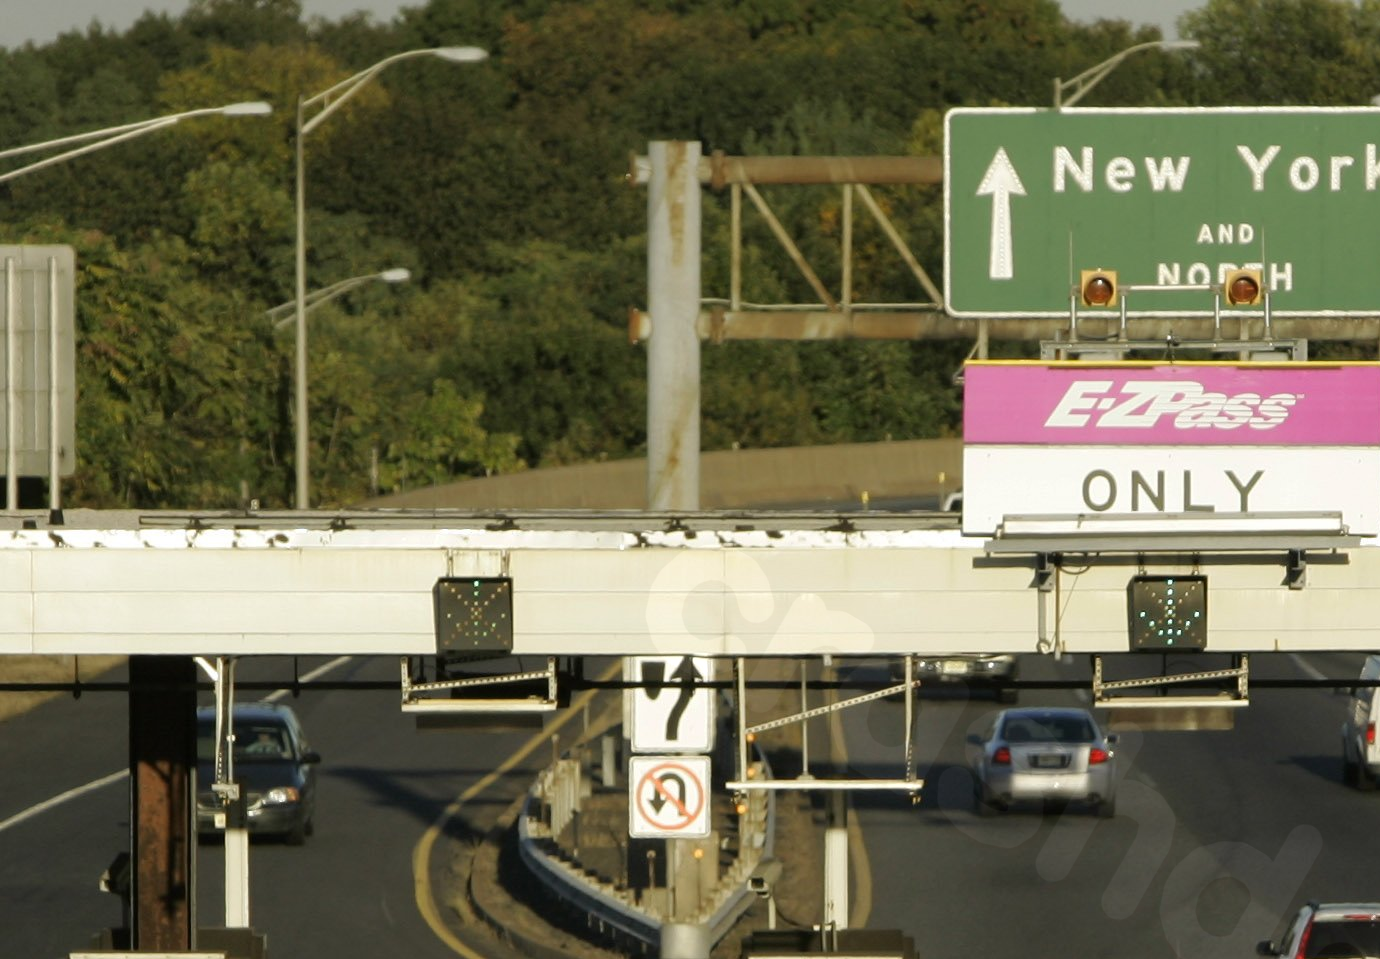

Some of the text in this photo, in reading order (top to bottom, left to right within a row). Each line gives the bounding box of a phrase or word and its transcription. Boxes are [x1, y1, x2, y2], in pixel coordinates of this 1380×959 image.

[1053, 146, 1191, 193] New
[1197, 223, 1255, 245] AND
[1082, 470, 1265, 512] ONLY
